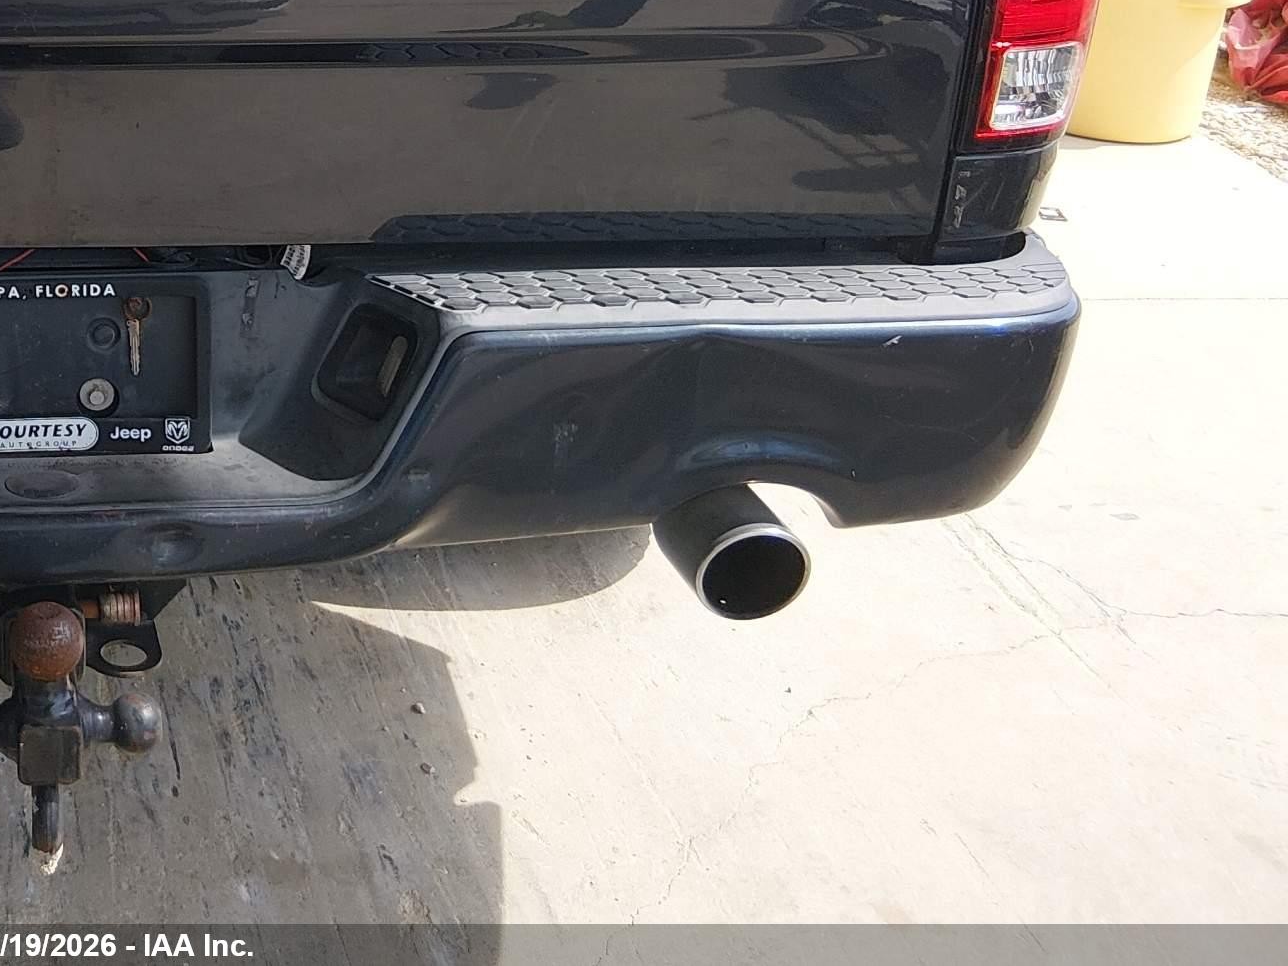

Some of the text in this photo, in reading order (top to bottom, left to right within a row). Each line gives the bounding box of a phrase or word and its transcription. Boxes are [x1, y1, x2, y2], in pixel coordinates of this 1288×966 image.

[35, 283, 116, 299] FLORIDA
[110, 426, 152, 443] Jeep
[0, 440, 77, 449] AUTOGROUP
